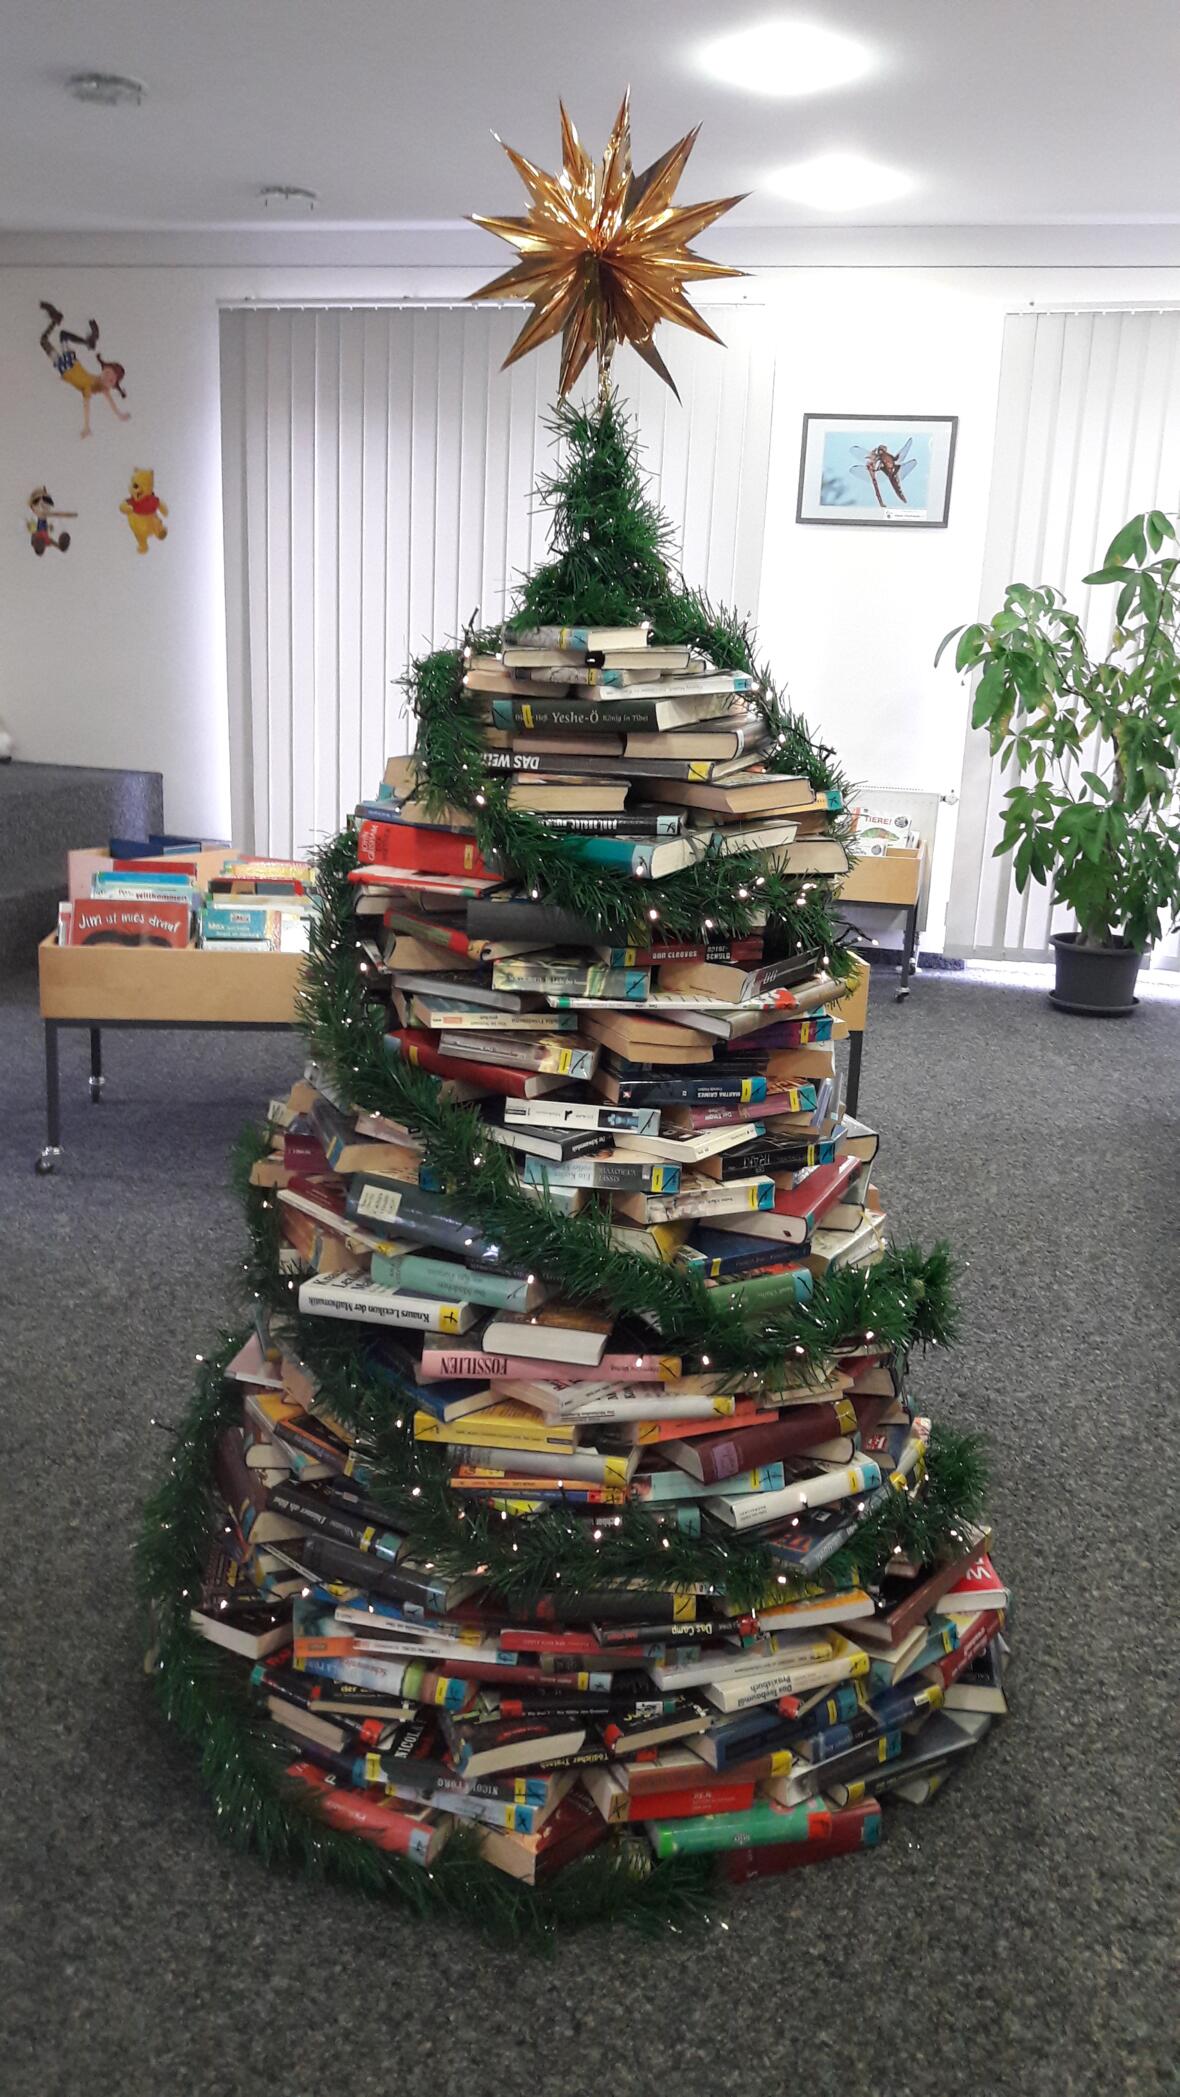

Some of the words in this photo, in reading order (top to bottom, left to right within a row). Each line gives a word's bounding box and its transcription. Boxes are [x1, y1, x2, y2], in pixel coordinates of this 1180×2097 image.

[552, 709, 600, 724] Yeshe-Ö
[512, 756, 540, 770] DAS
[78, 912, 103, 930] Jim
[105, 914, 117, 925] ist
[121, 911, 145, 925] mies
[148, 915, 183, 933] drauf
[308, 1297, 353, 1312] Mathematik
[353, 1302, 368, 1312] der
[368, 1305, 401, 1319] Lexikon
[400, 1310, 430, 1323] Knaurs
[440, 1356, 509, 1376] FOSSILIEN
[671, 1624, 695, 1637] Camp
[699, 1623, 713, 1636] Das
[749, 1674, 792, 1691] Praxisbuch
[737, 1687, 778, 1708] Teebaumöl
[778, 1684, 793, 1698] Das
[574, 1751, 609, 1764] Tödlicher
